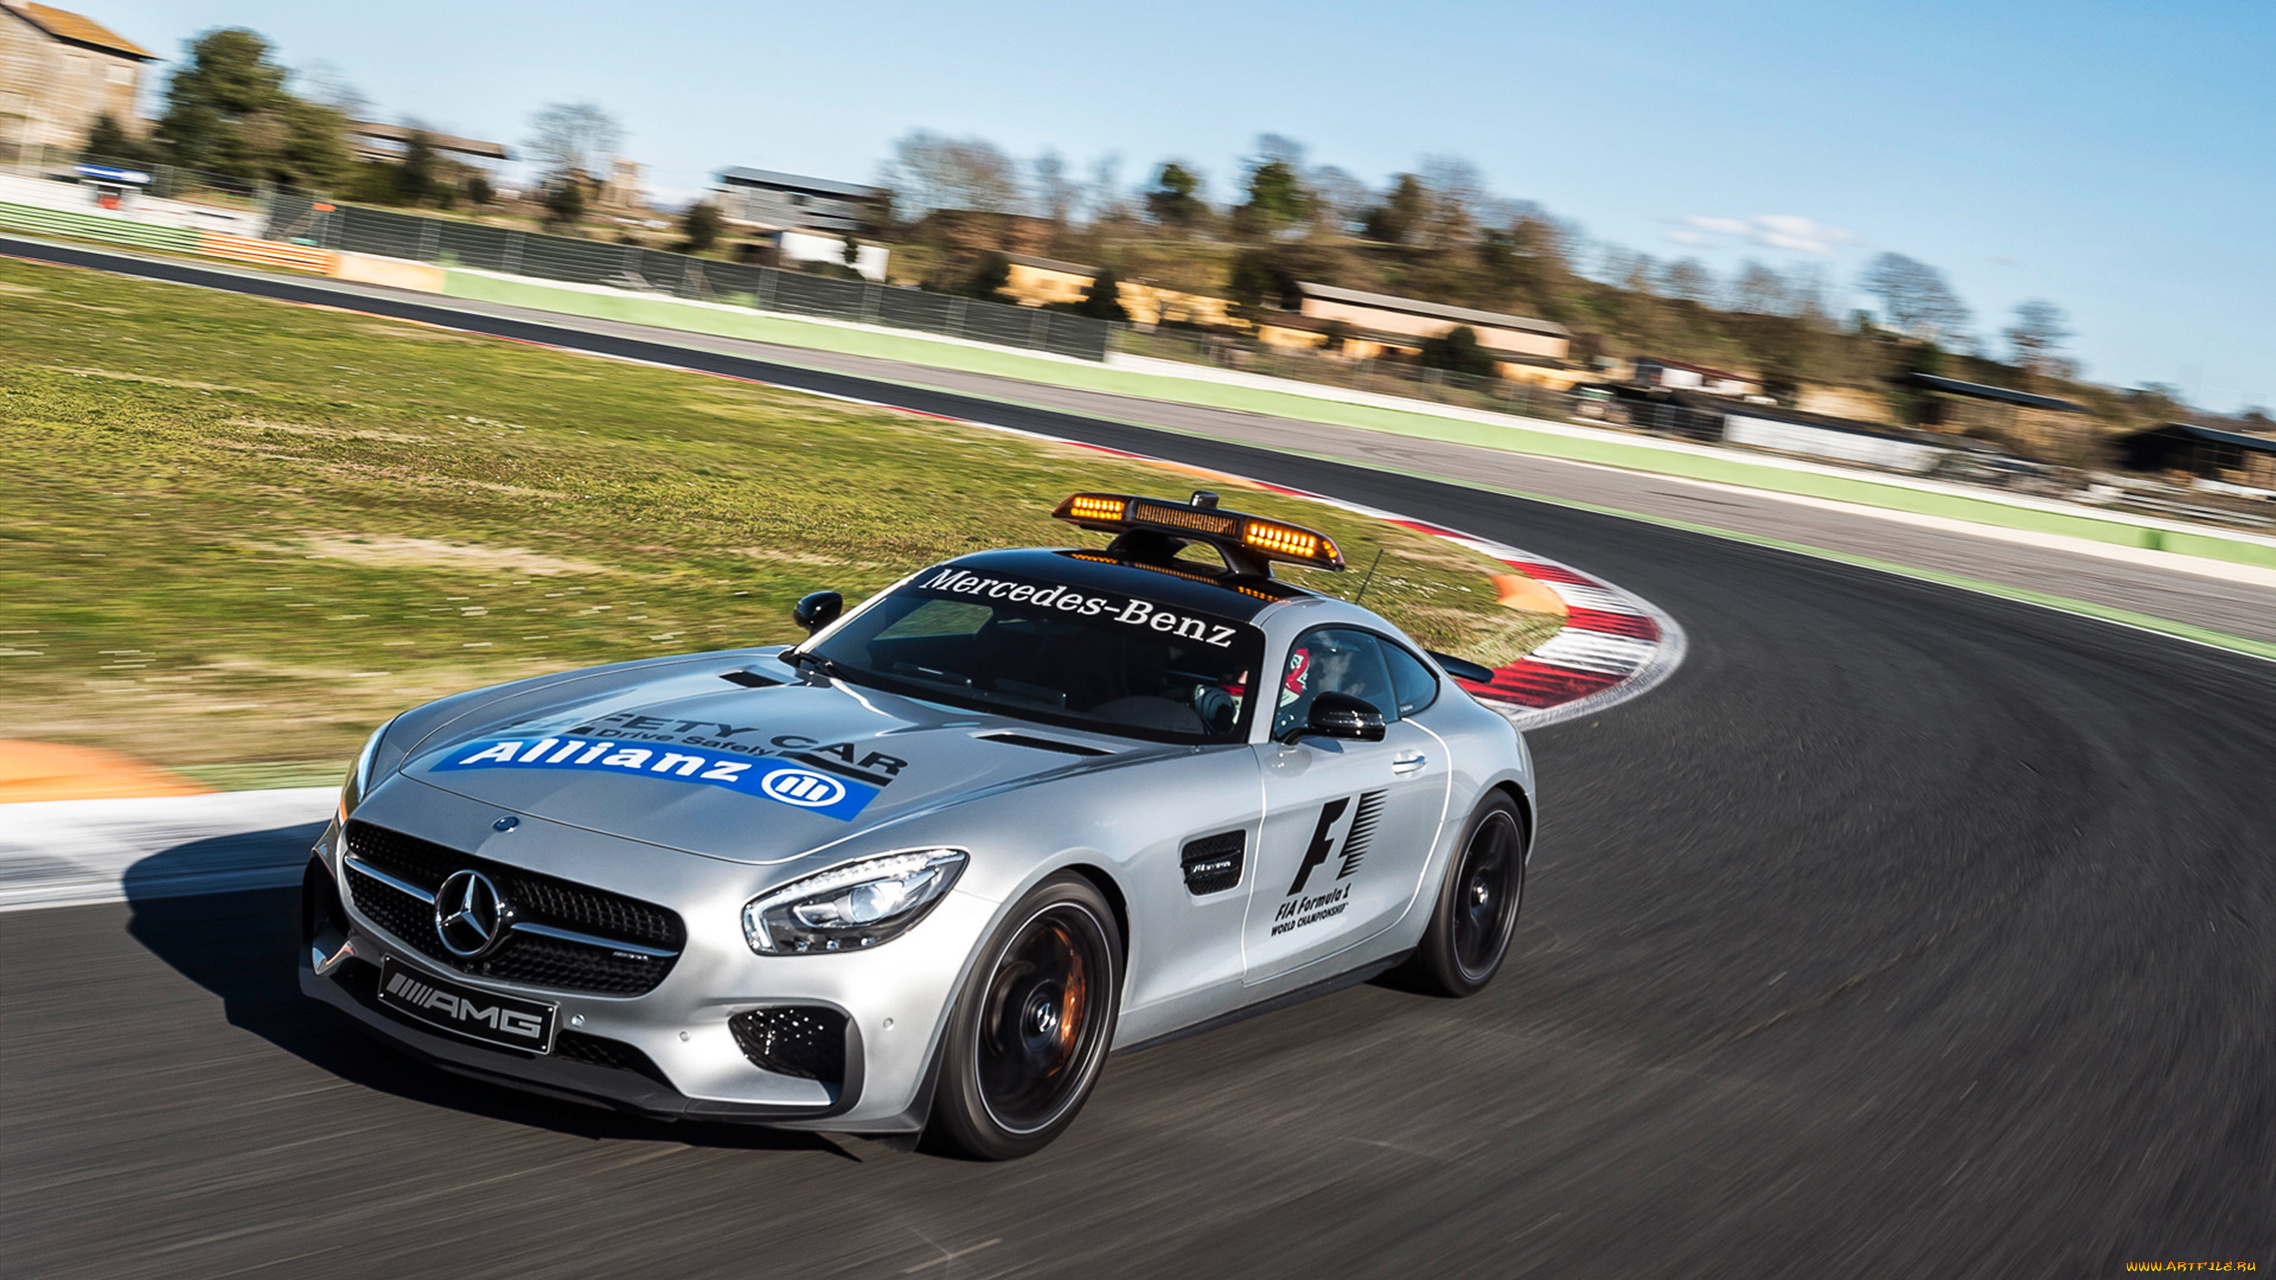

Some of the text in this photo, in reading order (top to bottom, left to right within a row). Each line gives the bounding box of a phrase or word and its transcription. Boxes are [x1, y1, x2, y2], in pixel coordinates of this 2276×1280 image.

[918, 568, 1237, 648] Mercedes-Benz
[457, 737, 753, 783] Allianz
[595, 728, 777, 757] Drive Safely
[769, 735, 909, 776] CAR
[1271, 902, 1348, 937] WORLD CHAMPIONSHIP
[1274, 882, 1352, 922] FIA Formula 1
[422, 988, 543, 1039] AMG
